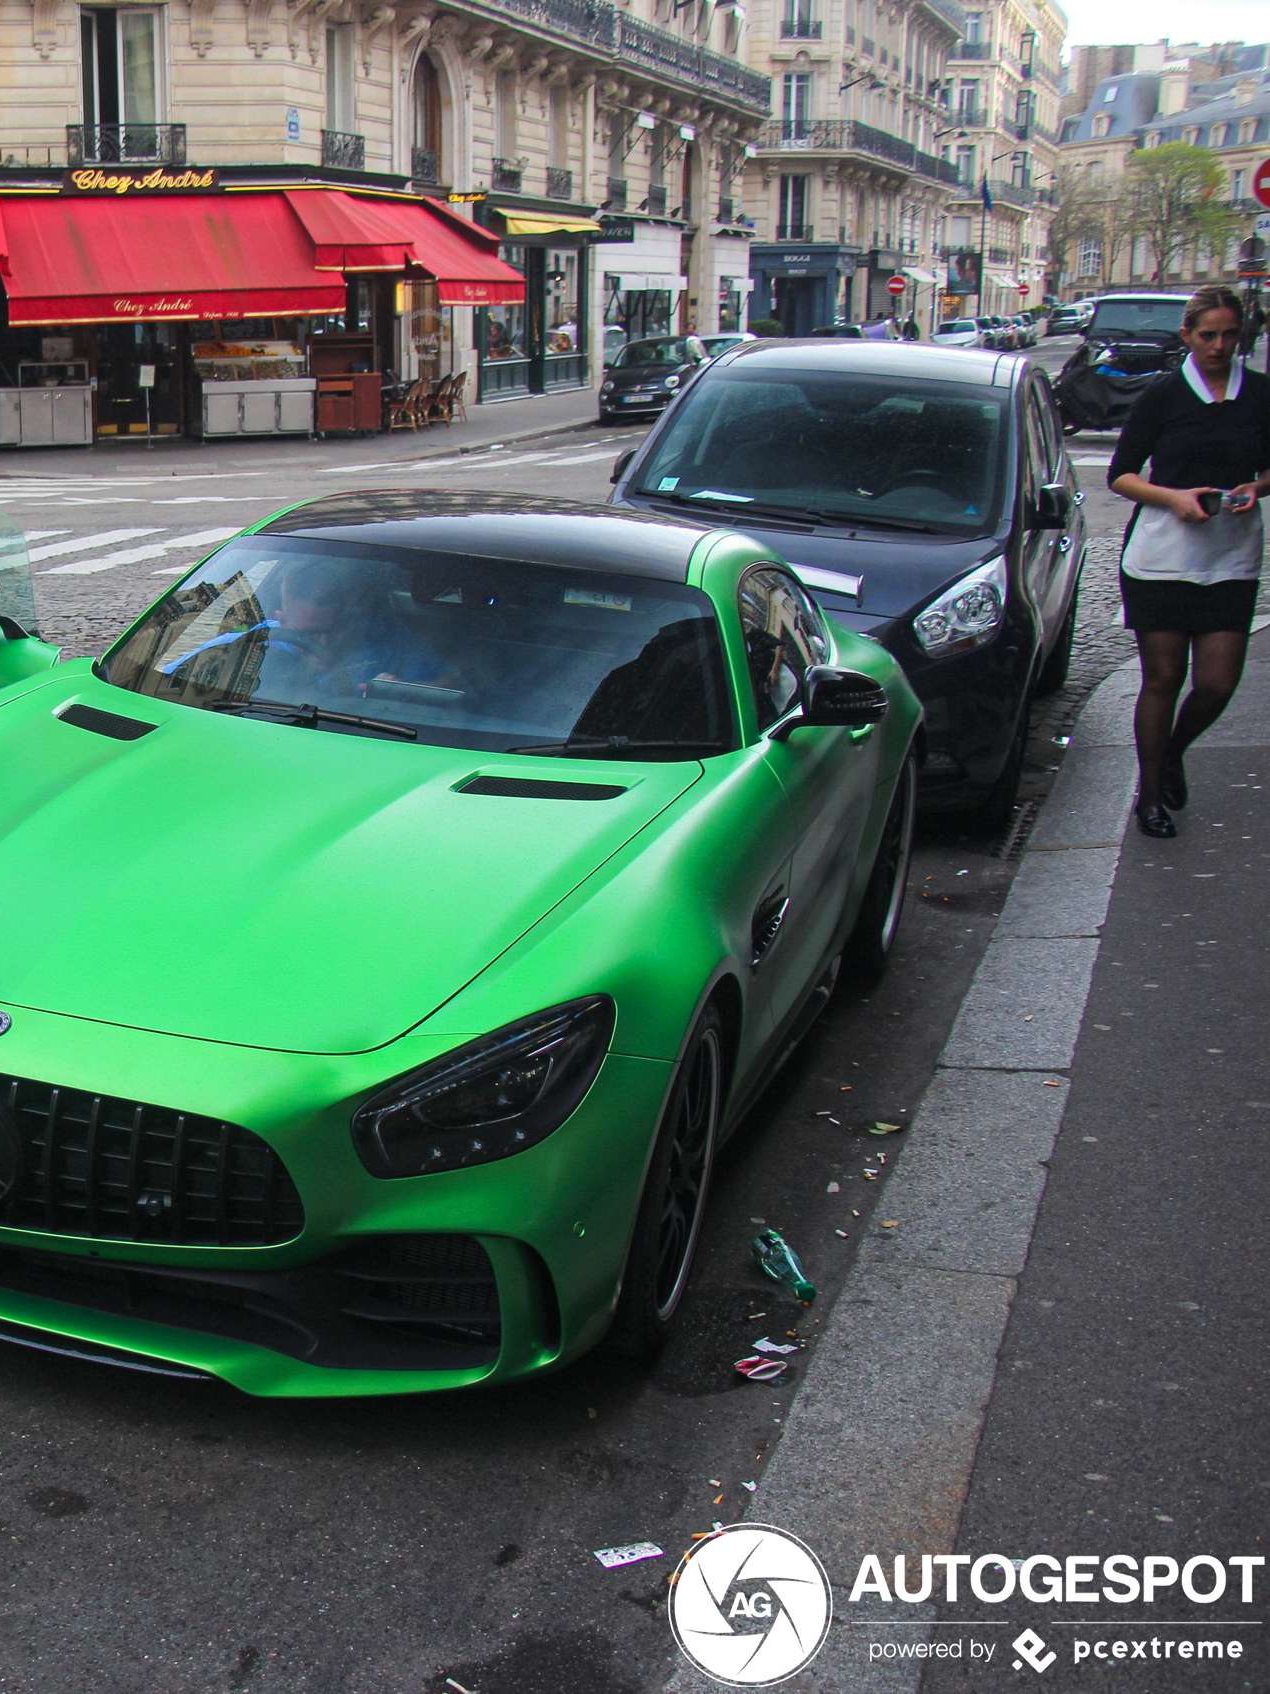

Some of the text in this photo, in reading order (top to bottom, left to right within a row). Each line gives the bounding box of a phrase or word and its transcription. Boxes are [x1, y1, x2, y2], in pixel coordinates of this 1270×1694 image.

[71, 168, 215, 194] Chez André
[113, 298, 194, 316] Chez André
